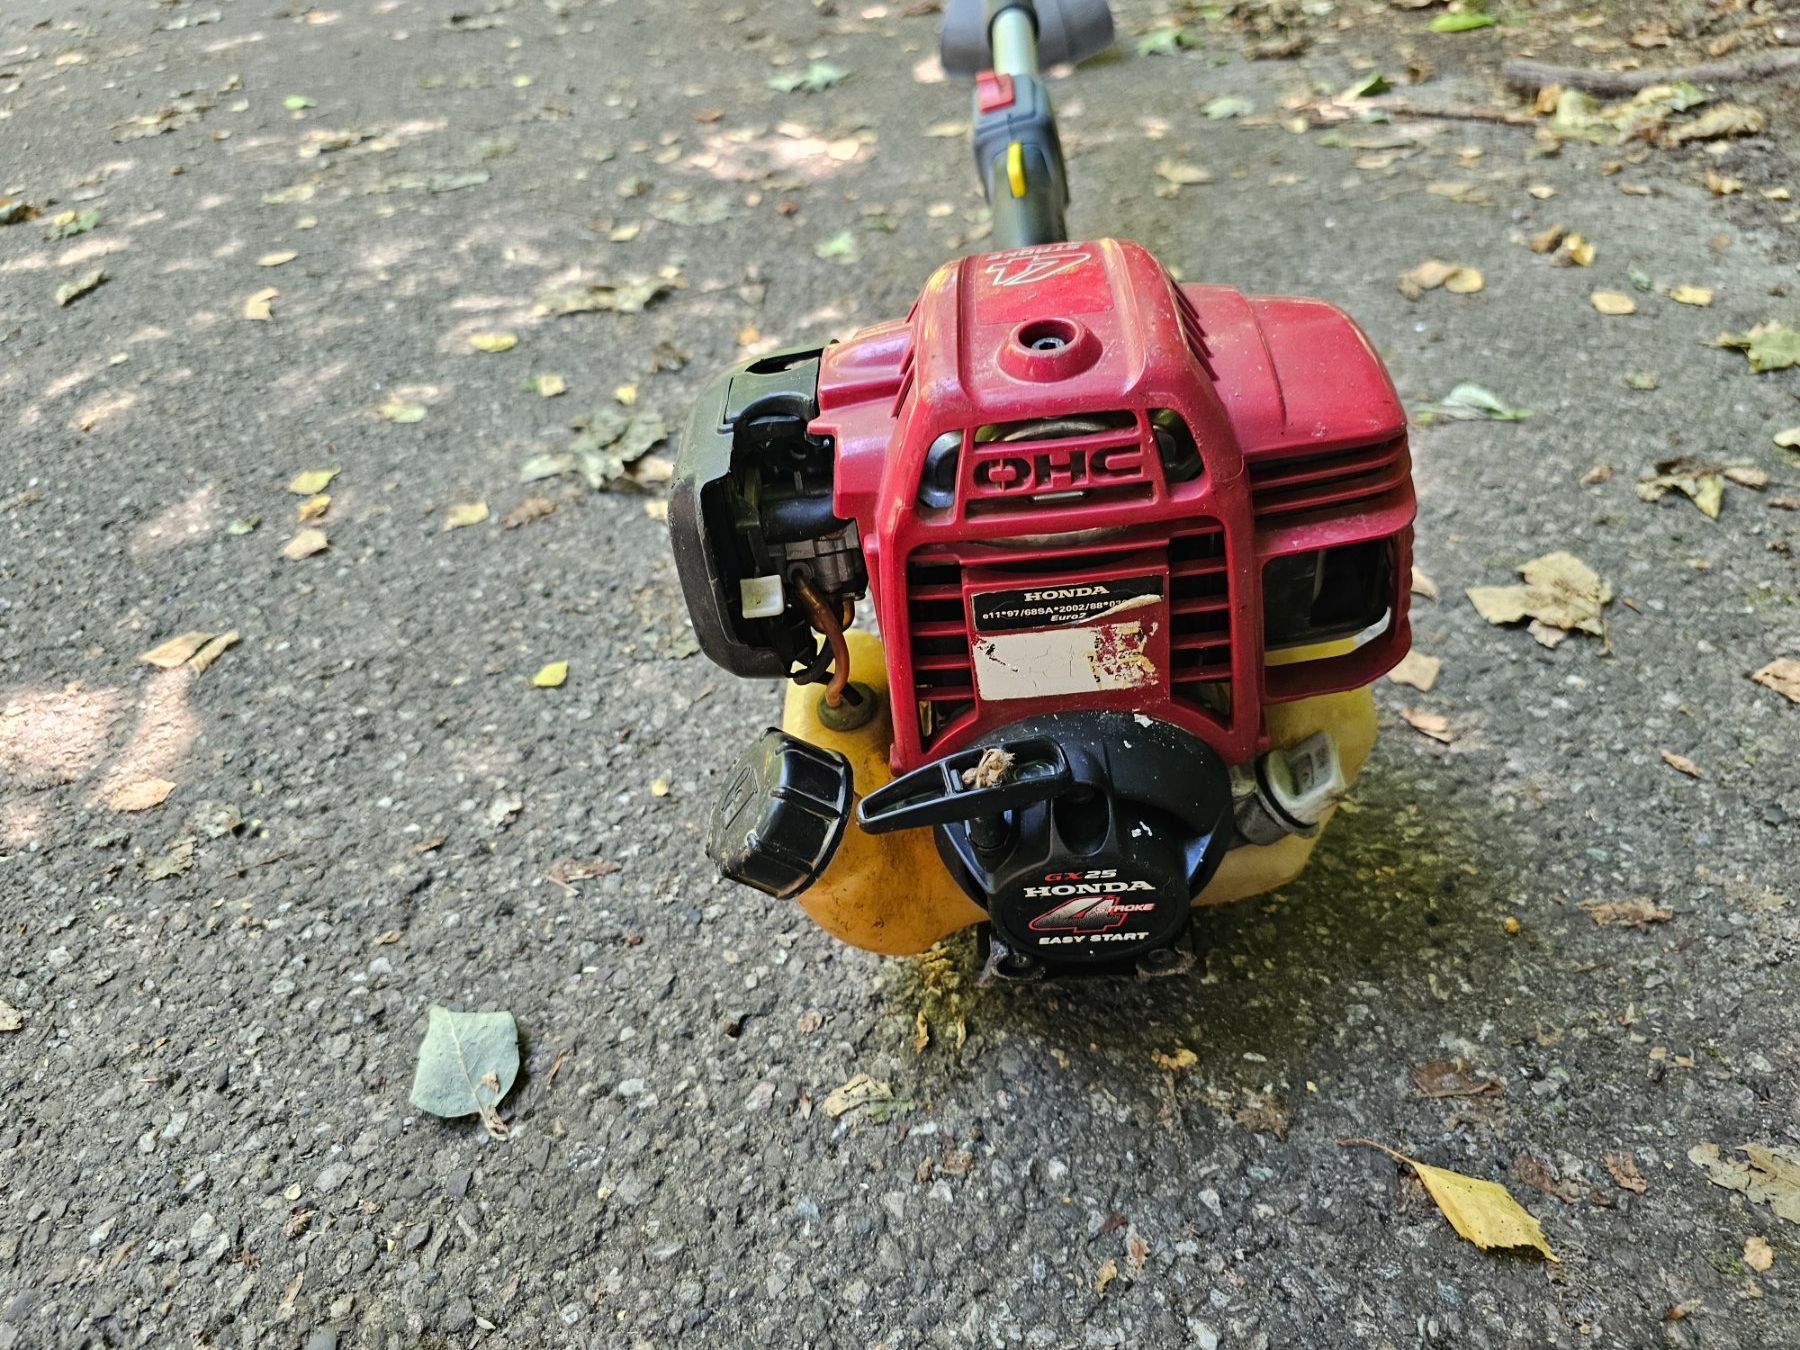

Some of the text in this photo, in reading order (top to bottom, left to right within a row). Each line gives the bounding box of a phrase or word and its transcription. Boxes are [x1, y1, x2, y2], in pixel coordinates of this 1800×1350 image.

[973, 443, 1144, 493] OHC
[1023, 585, 1110, 602] HONDA
[1050, 612, 1087, 622] Euro2
[1023, 880, 1157, 898] HONDA
[1028, 895, 1156, 933] 4 STROKE
[1038, 932, 1150, 945] EASY START
